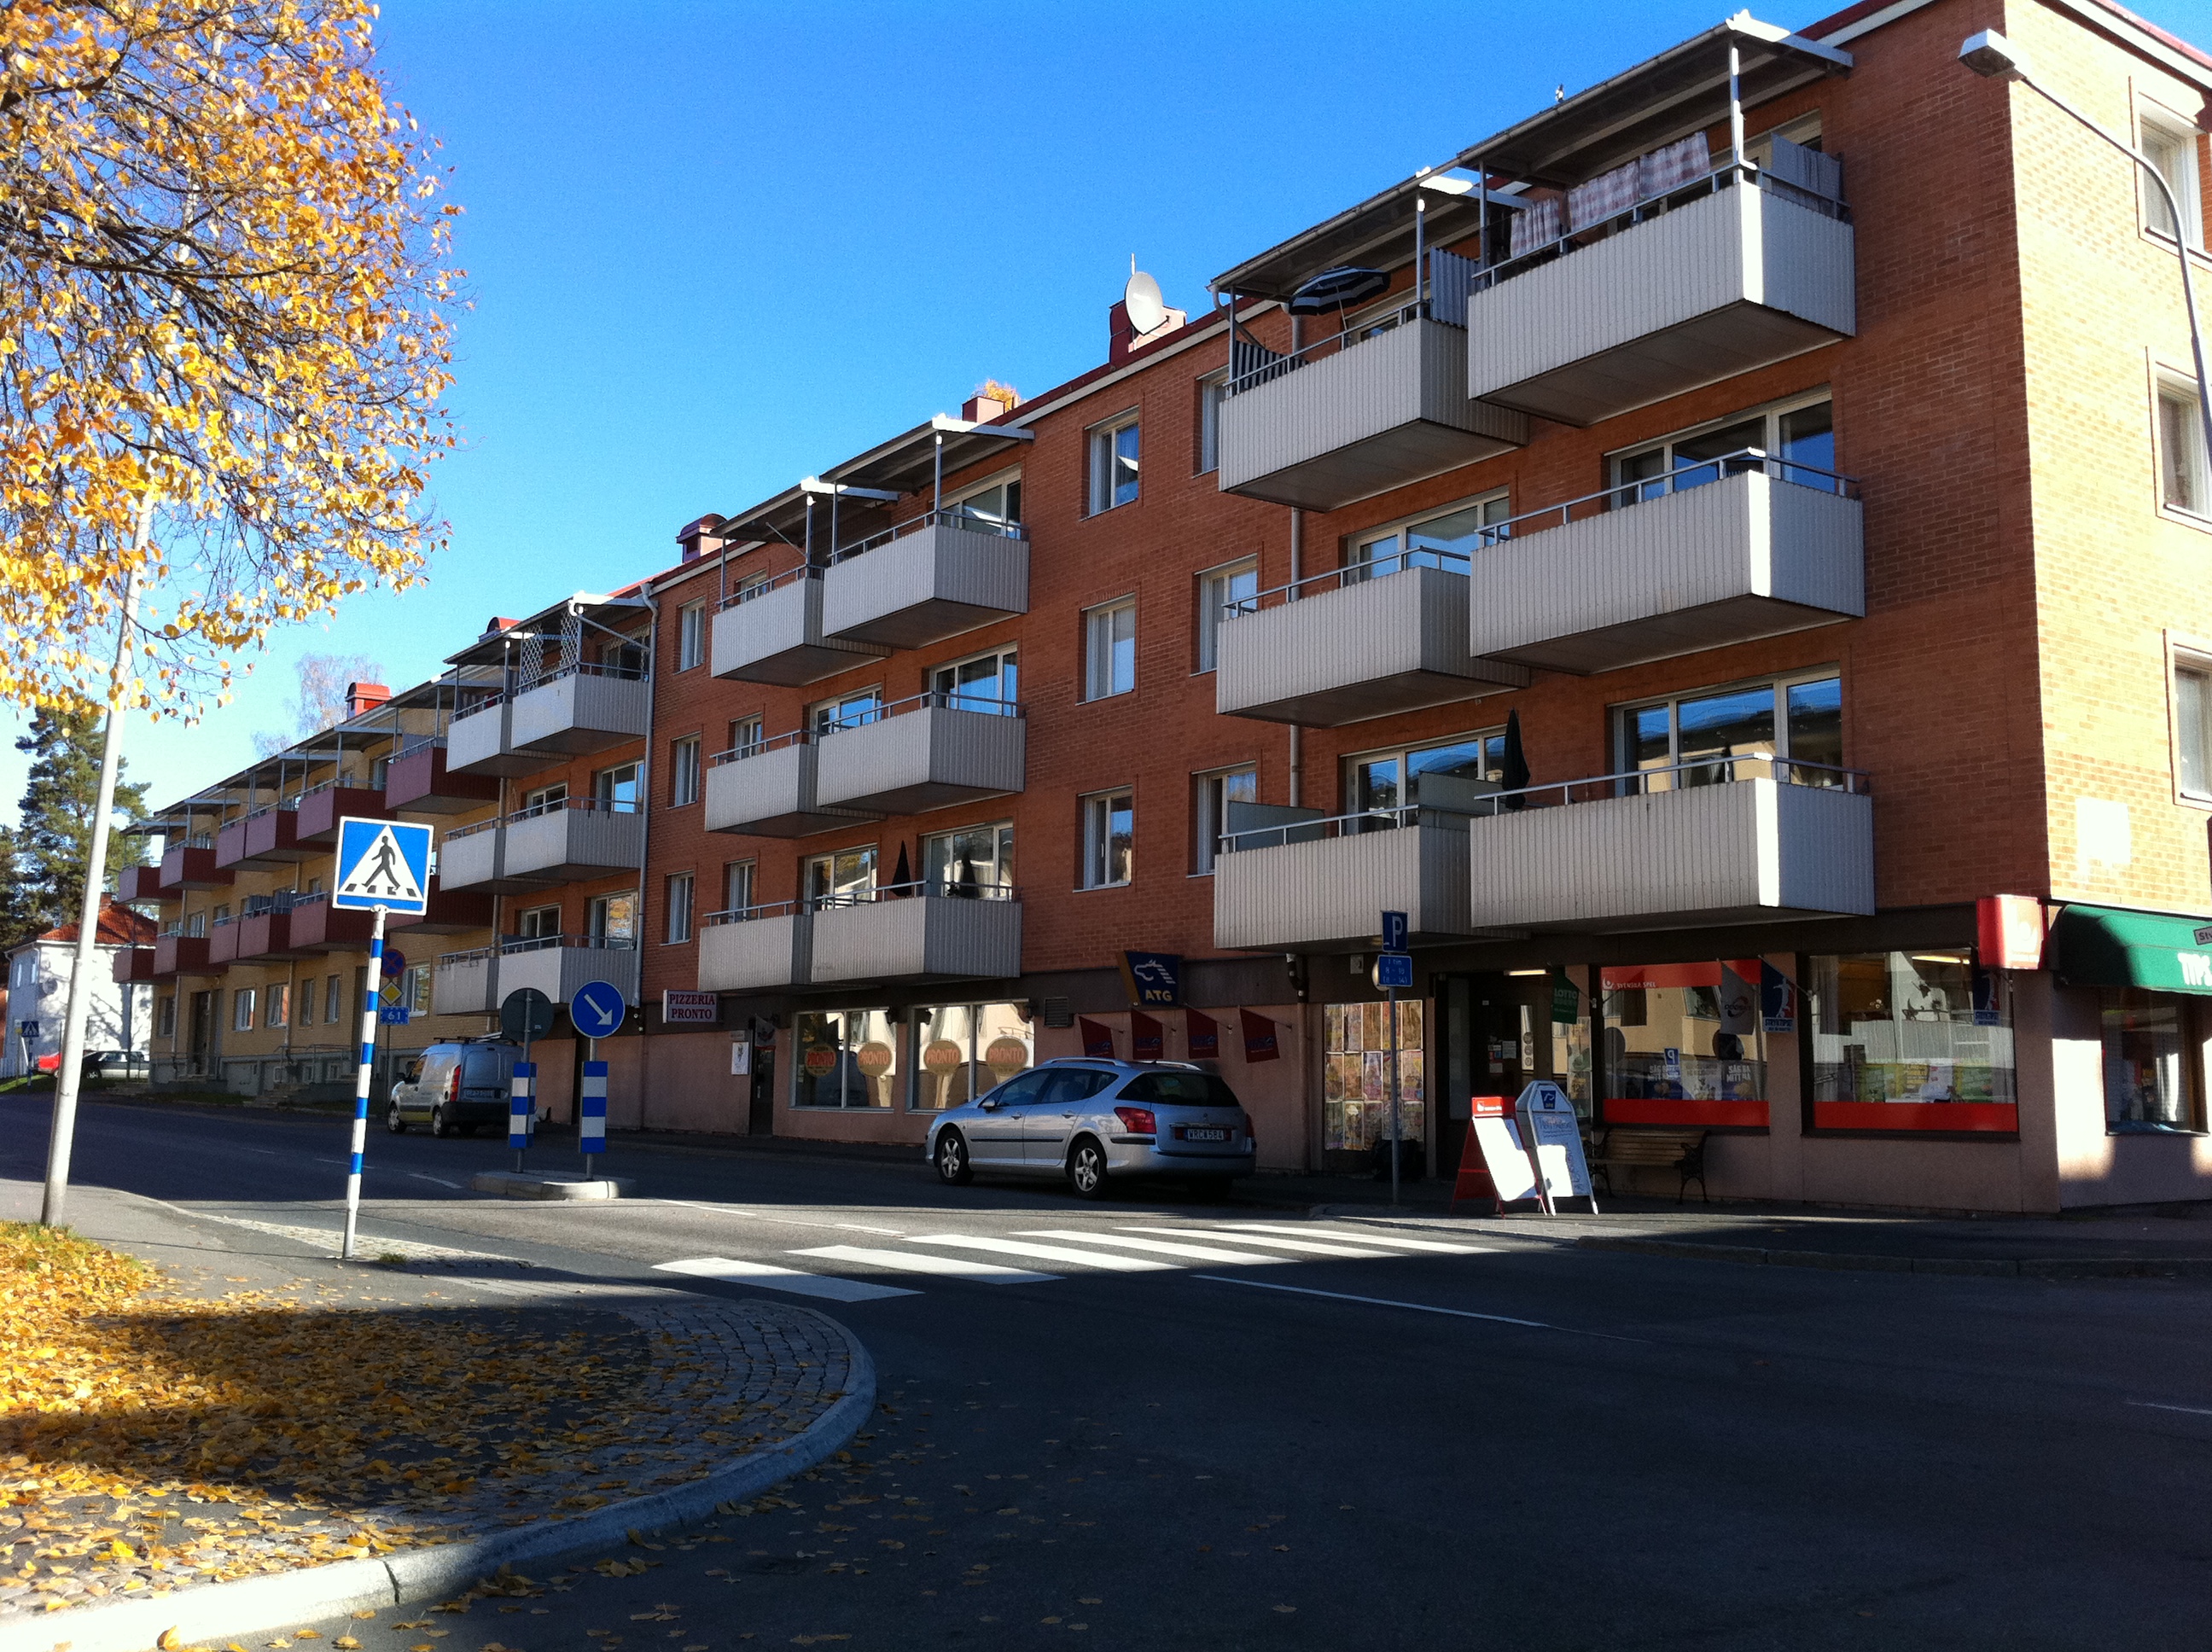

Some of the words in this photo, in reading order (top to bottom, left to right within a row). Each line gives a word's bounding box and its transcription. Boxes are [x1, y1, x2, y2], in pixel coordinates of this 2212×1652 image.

[1392, 916, 1403, 947] P
[669, 994, 715, 1005] PIZZERIA
[1145, 989, 1173, 1002] ATG
[1554, 988, 1577, 999] LOTTO
[388, 1011, 401, 1021] 61
[671, 1009, 712, 1019] PRONTO
[858, 1050, 888, 1065] PRONTO
[925, 1048, 958, 1064] PRONTO
[987, 1047, 1025, 1064] PRONTO
